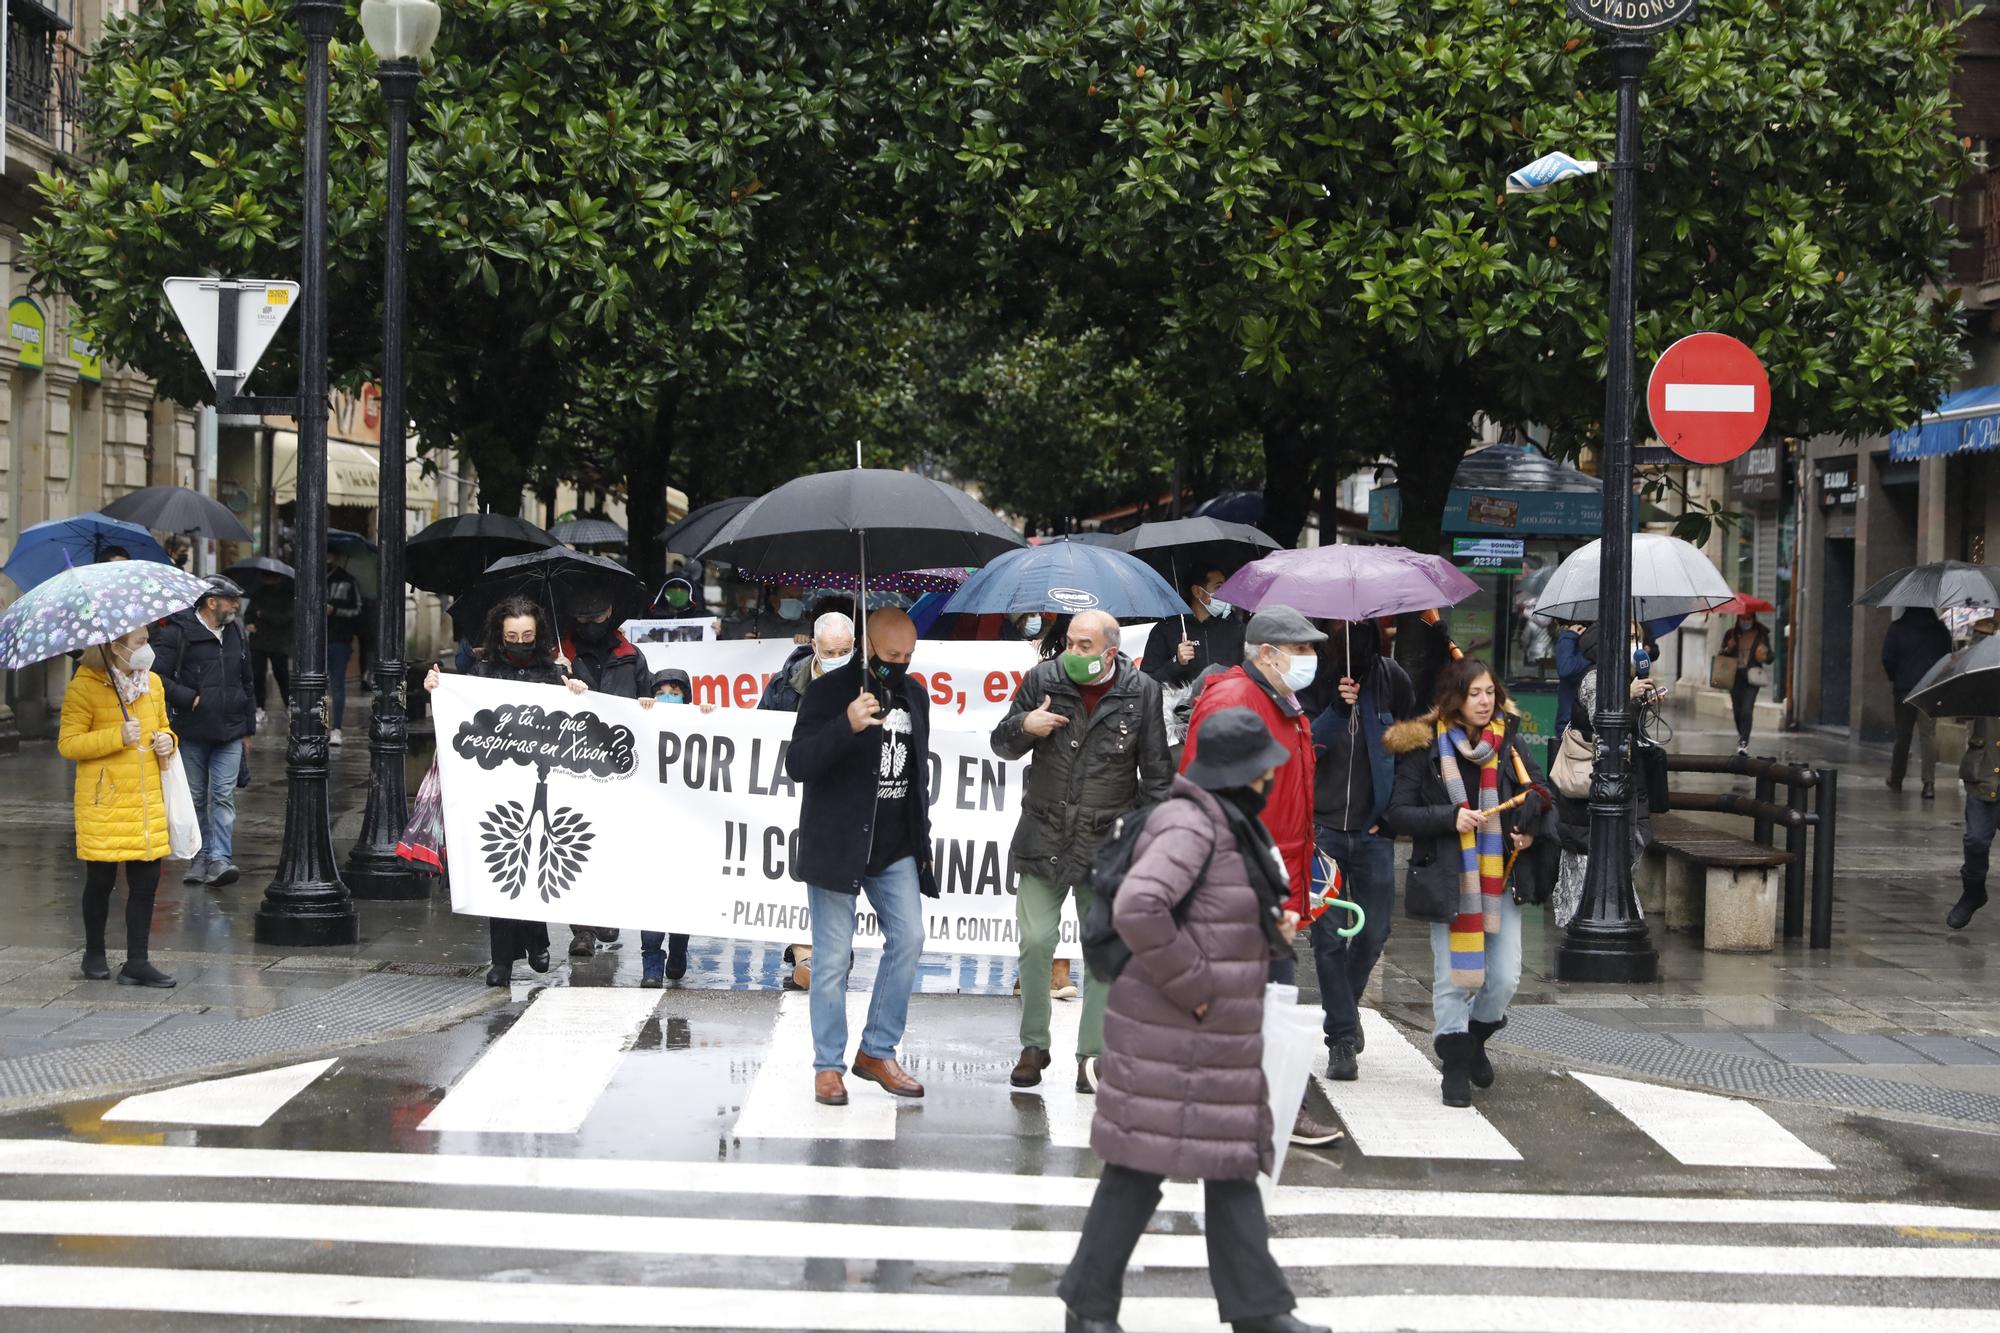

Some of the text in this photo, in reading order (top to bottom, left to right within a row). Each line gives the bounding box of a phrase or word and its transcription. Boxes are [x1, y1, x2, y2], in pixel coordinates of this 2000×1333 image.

[461, 732, 538, 759] respiras
[540, 742, 560, 758] en
[494, 711, 513, 733] y
[558, 713, 588, 741] qué
[658, 730, 797, 798] POR LA
[956, 754, 1006, 812] EN
[732, 900, 812, 931] PLATAFO
[855, 912, 881, 937] CO
[930, 915, 950, 940] LA
